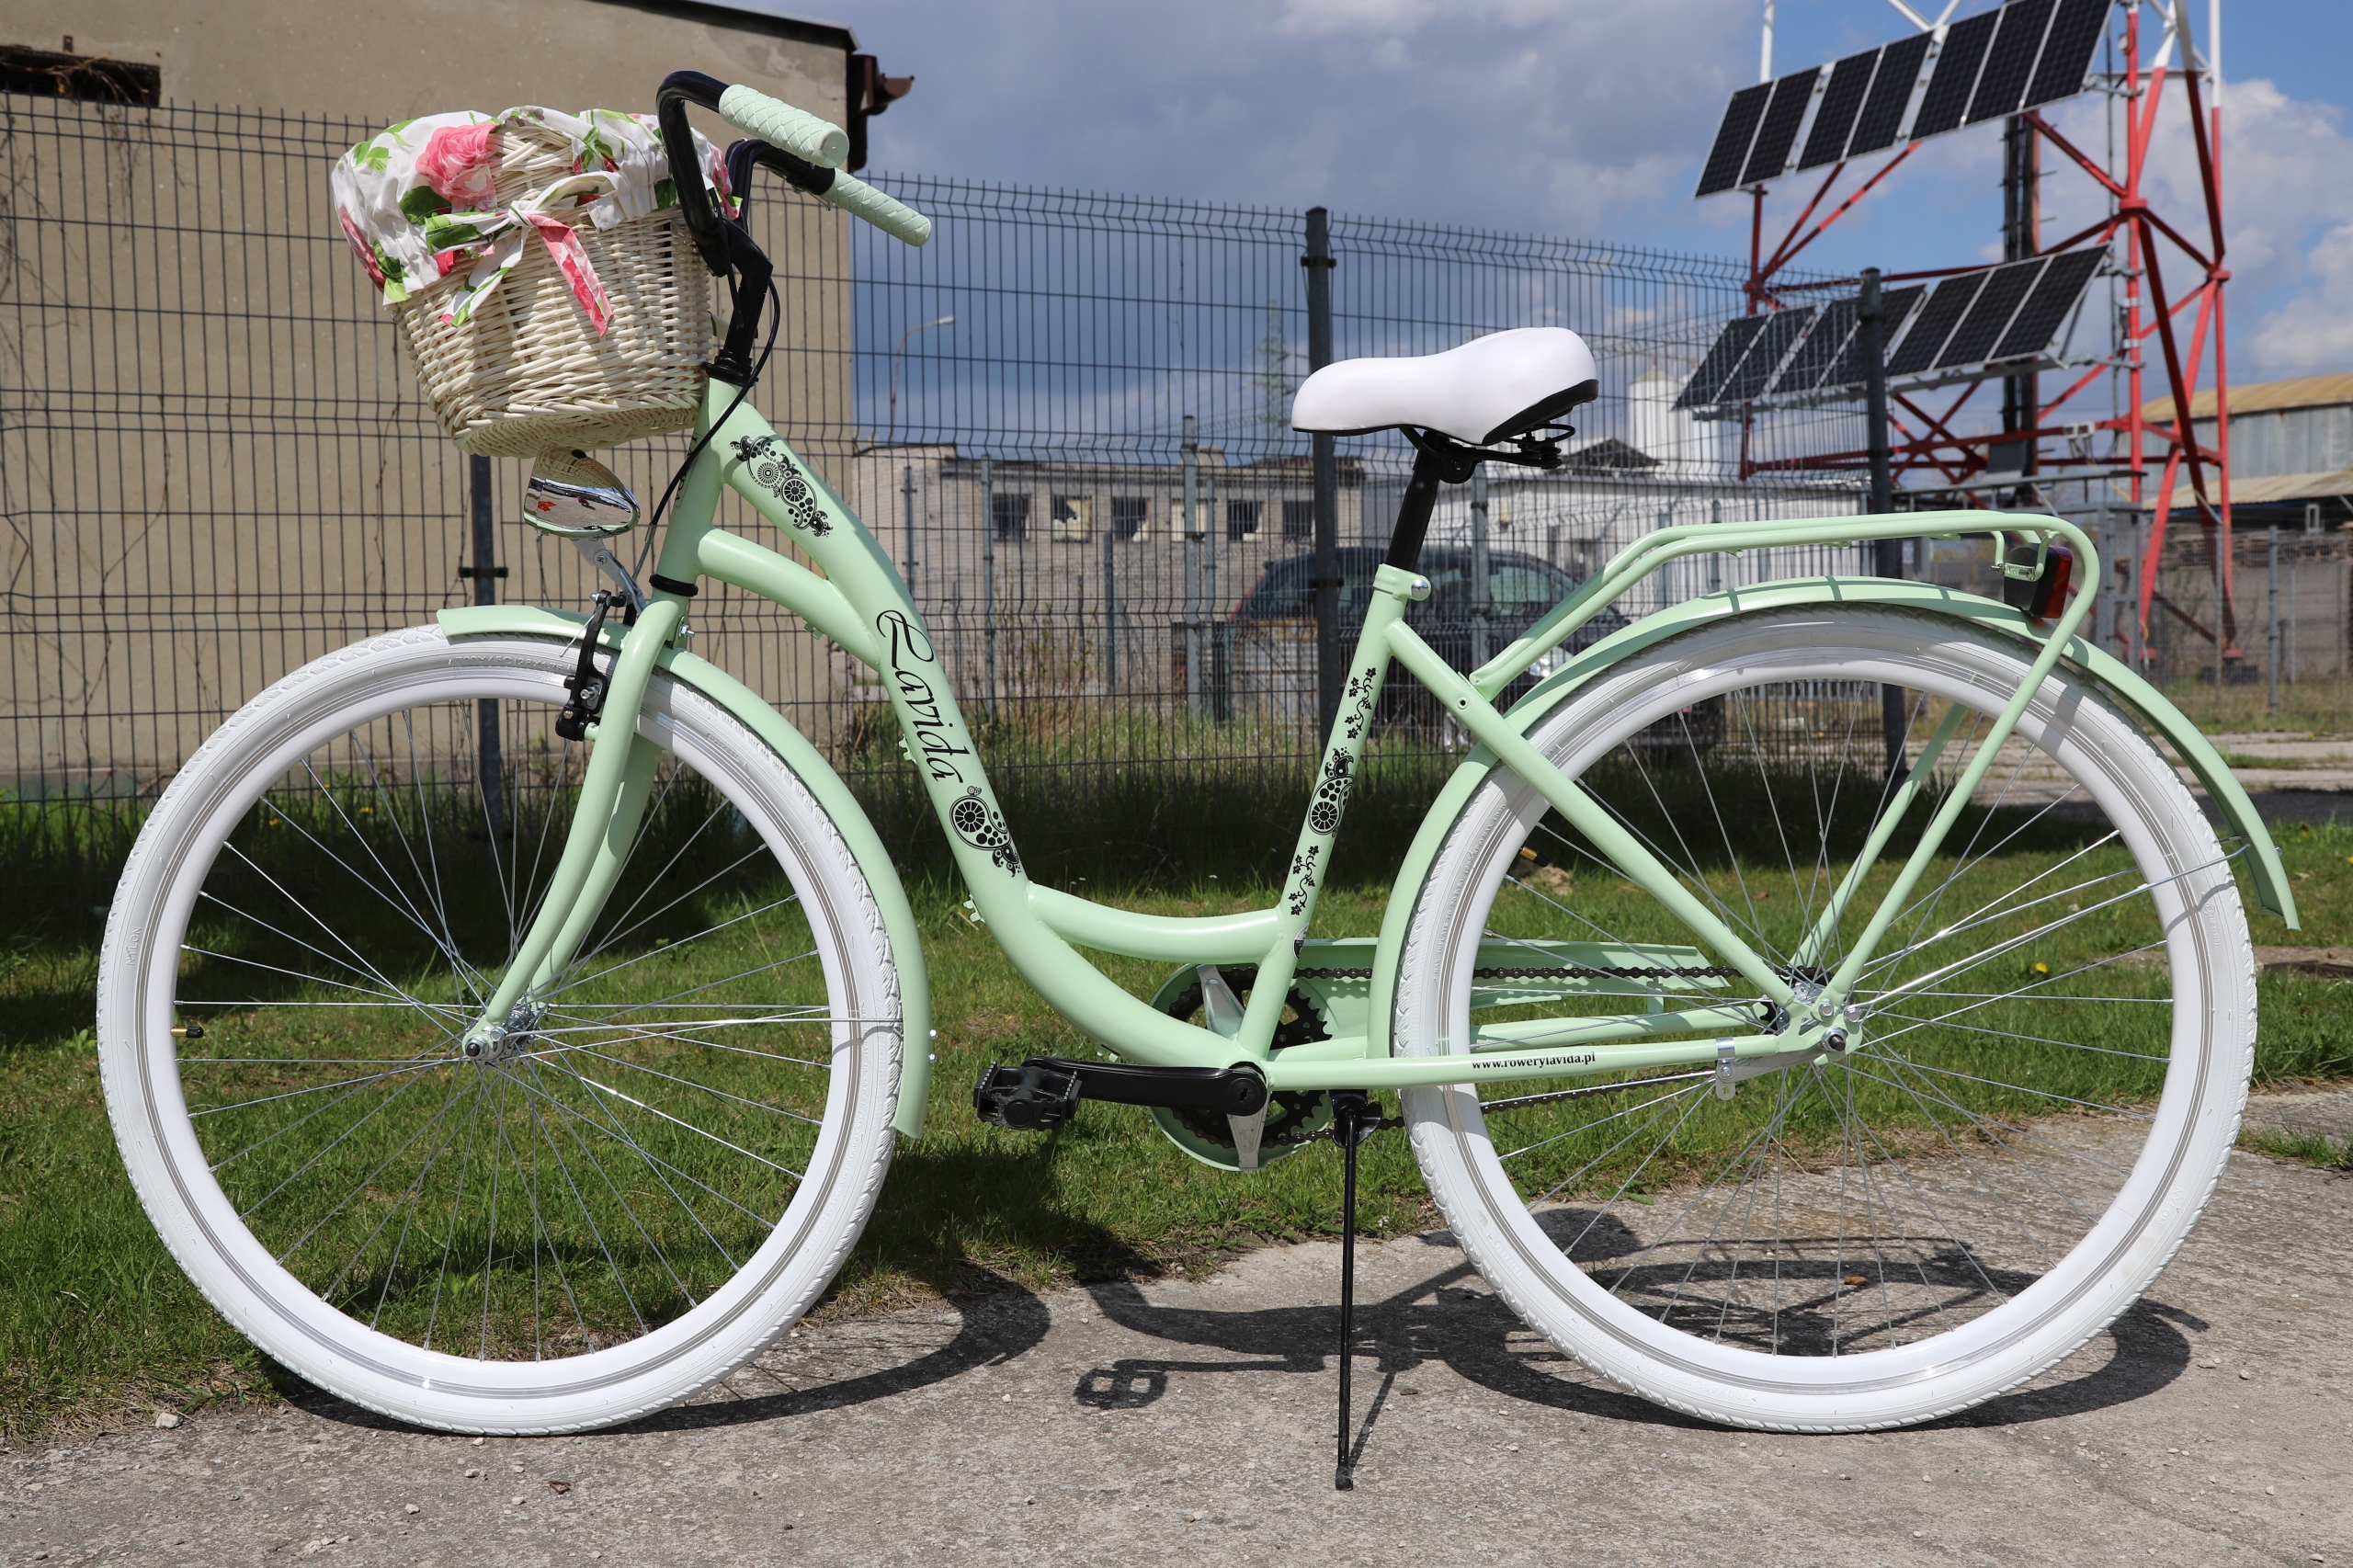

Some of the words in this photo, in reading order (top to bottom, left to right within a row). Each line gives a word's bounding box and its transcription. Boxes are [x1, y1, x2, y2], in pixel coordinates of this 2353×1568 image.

[876, 609, 971, 784] Lavida
[124, 926, 142, 966] NYLON
[1472, 1051, 1597, 1069] www.rowerylavida.pl
